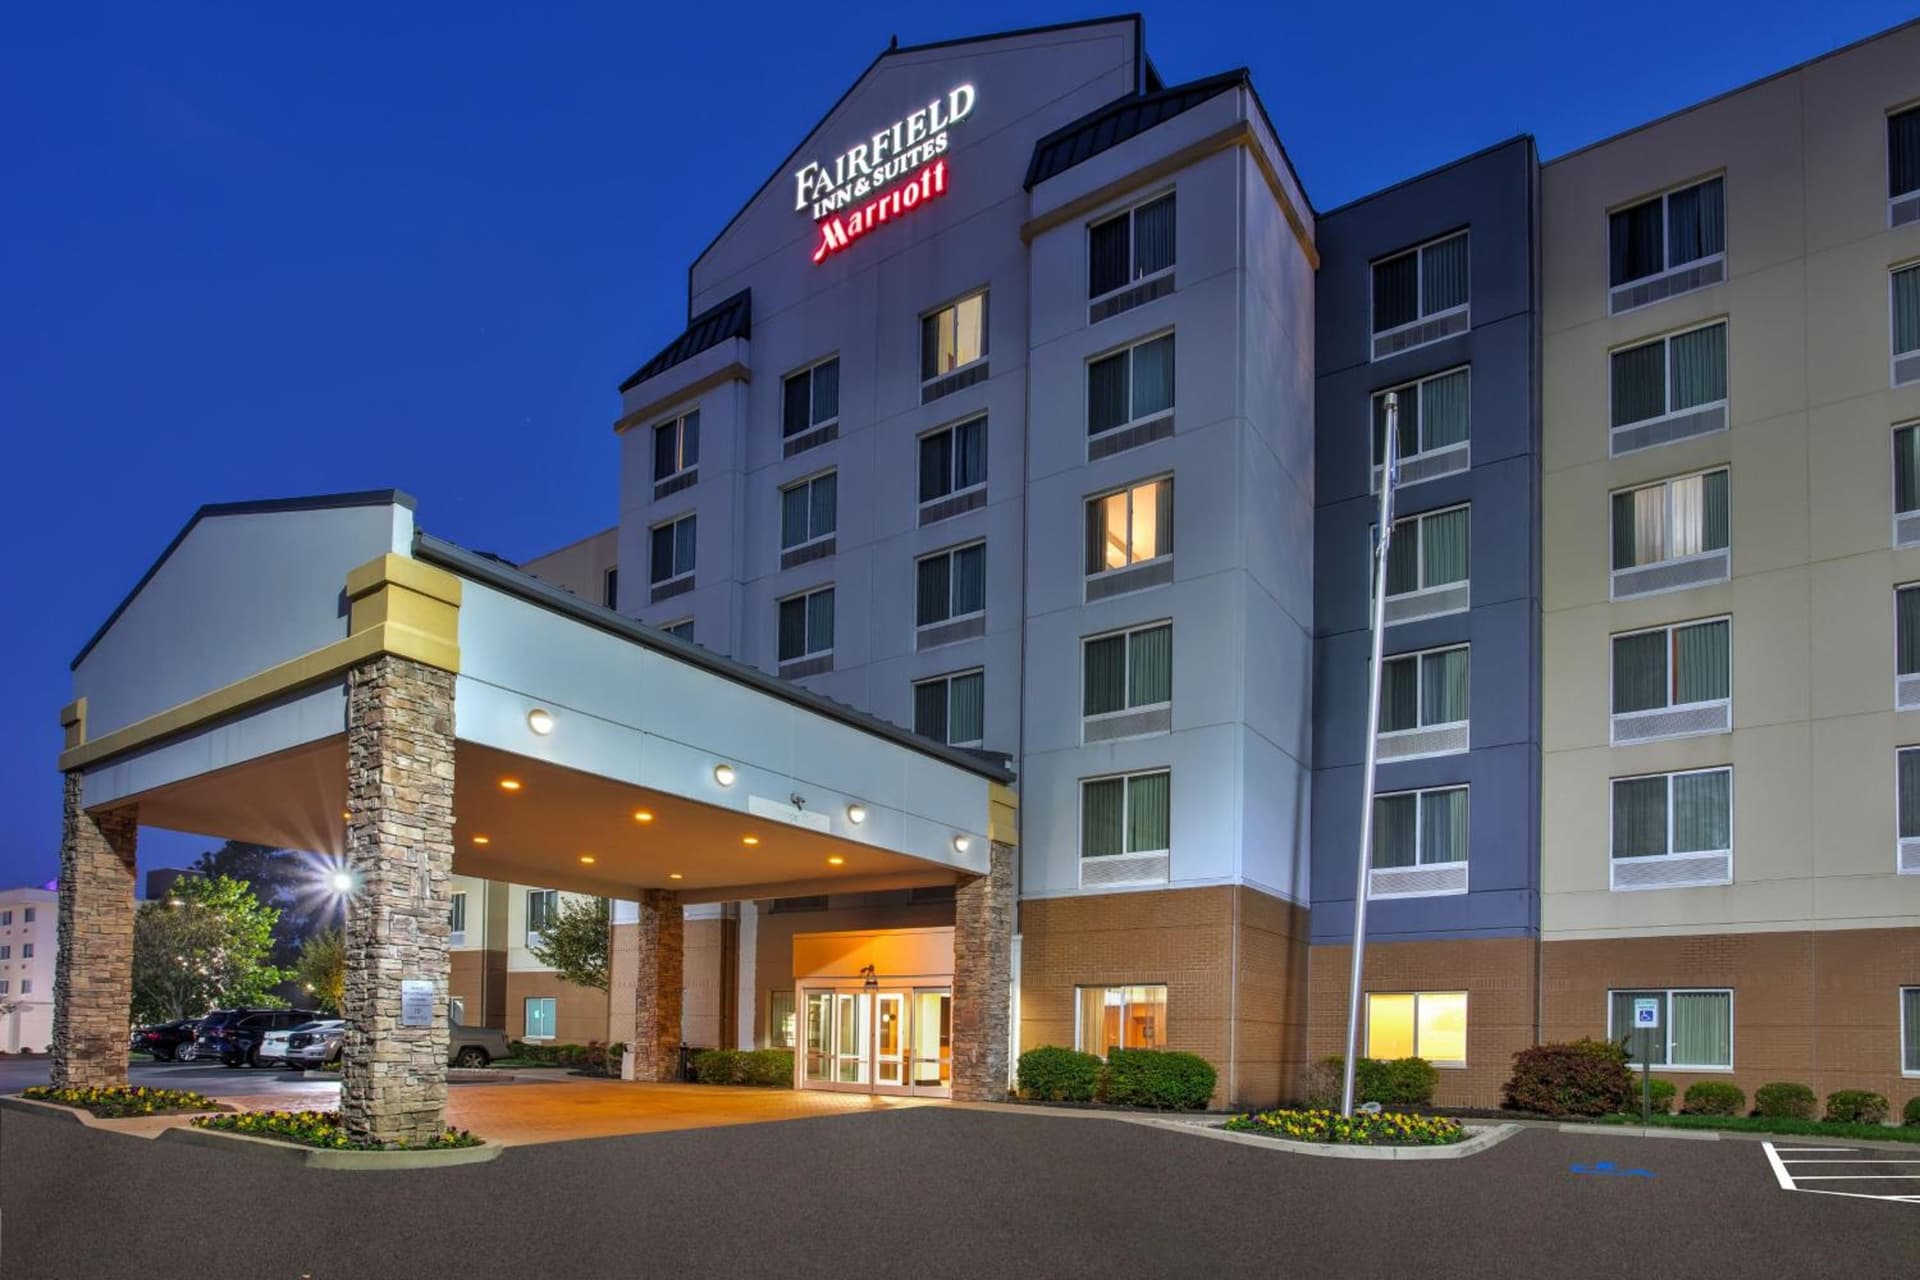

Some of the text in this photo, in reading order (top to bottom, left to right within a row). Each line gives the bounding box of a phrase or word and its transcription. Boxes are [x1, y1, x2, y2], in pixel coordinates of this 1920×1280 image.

[795, 84, 975, 211] FAIRFIELD
[813, 131, 948, 220] INN & SUITES
[813, 161, 946, 262] Marriott
